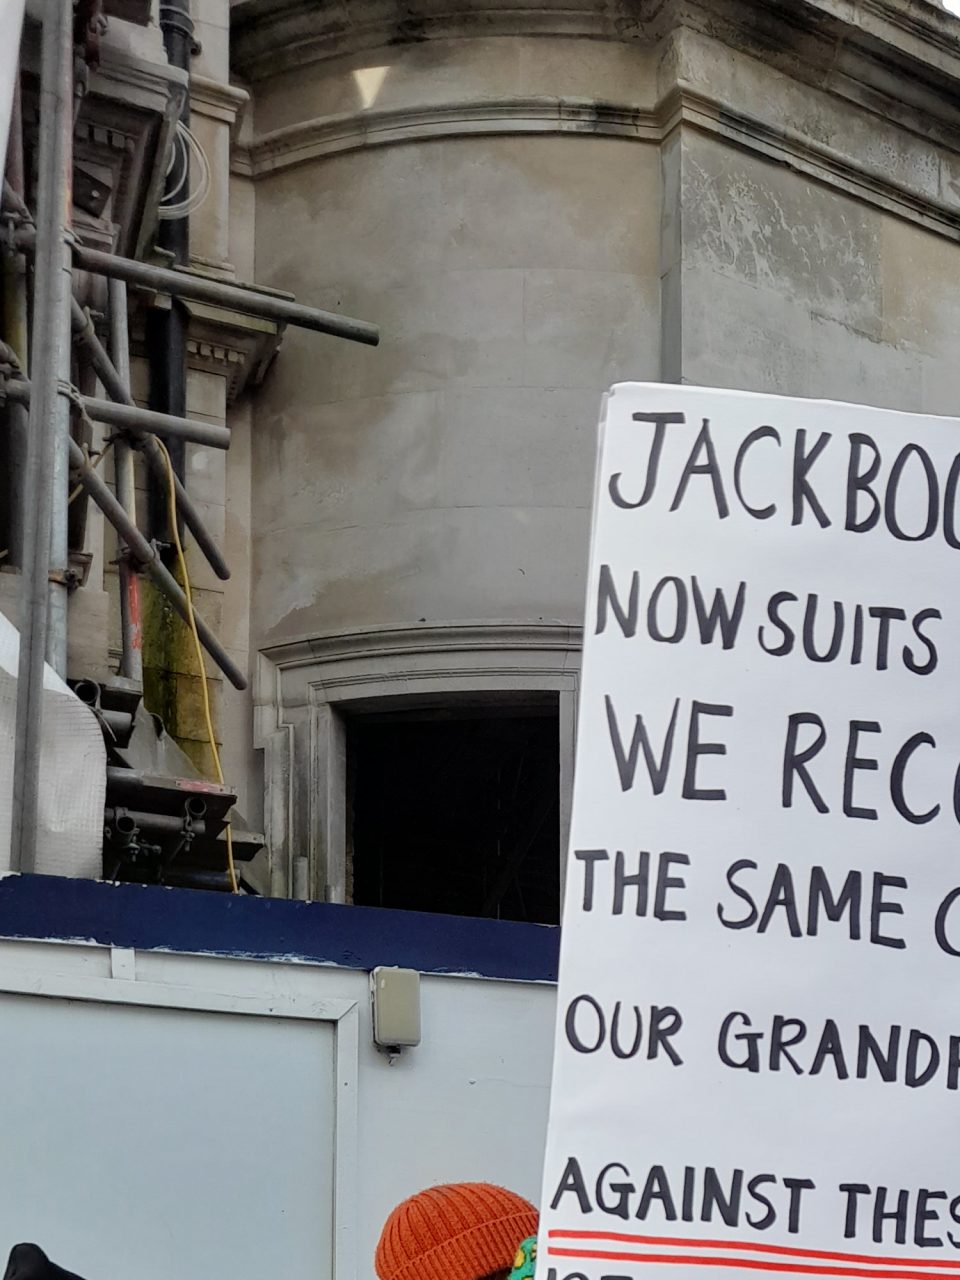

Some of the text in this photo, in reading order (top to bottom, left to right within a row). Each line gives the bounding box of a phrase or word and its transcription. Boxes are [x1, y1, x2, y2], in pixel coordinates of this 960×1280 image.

[594, 564, 746, 651] NOW
[757, 590, 943, 676] SUITS
[604, 694, 734, 801] WE
[573, 848, 692, 922] THE
[716, 858, 908, 950] SAME
[564, 994, 684, 1067] OUR
[550, 1156, 816, 1234] AGAINST
